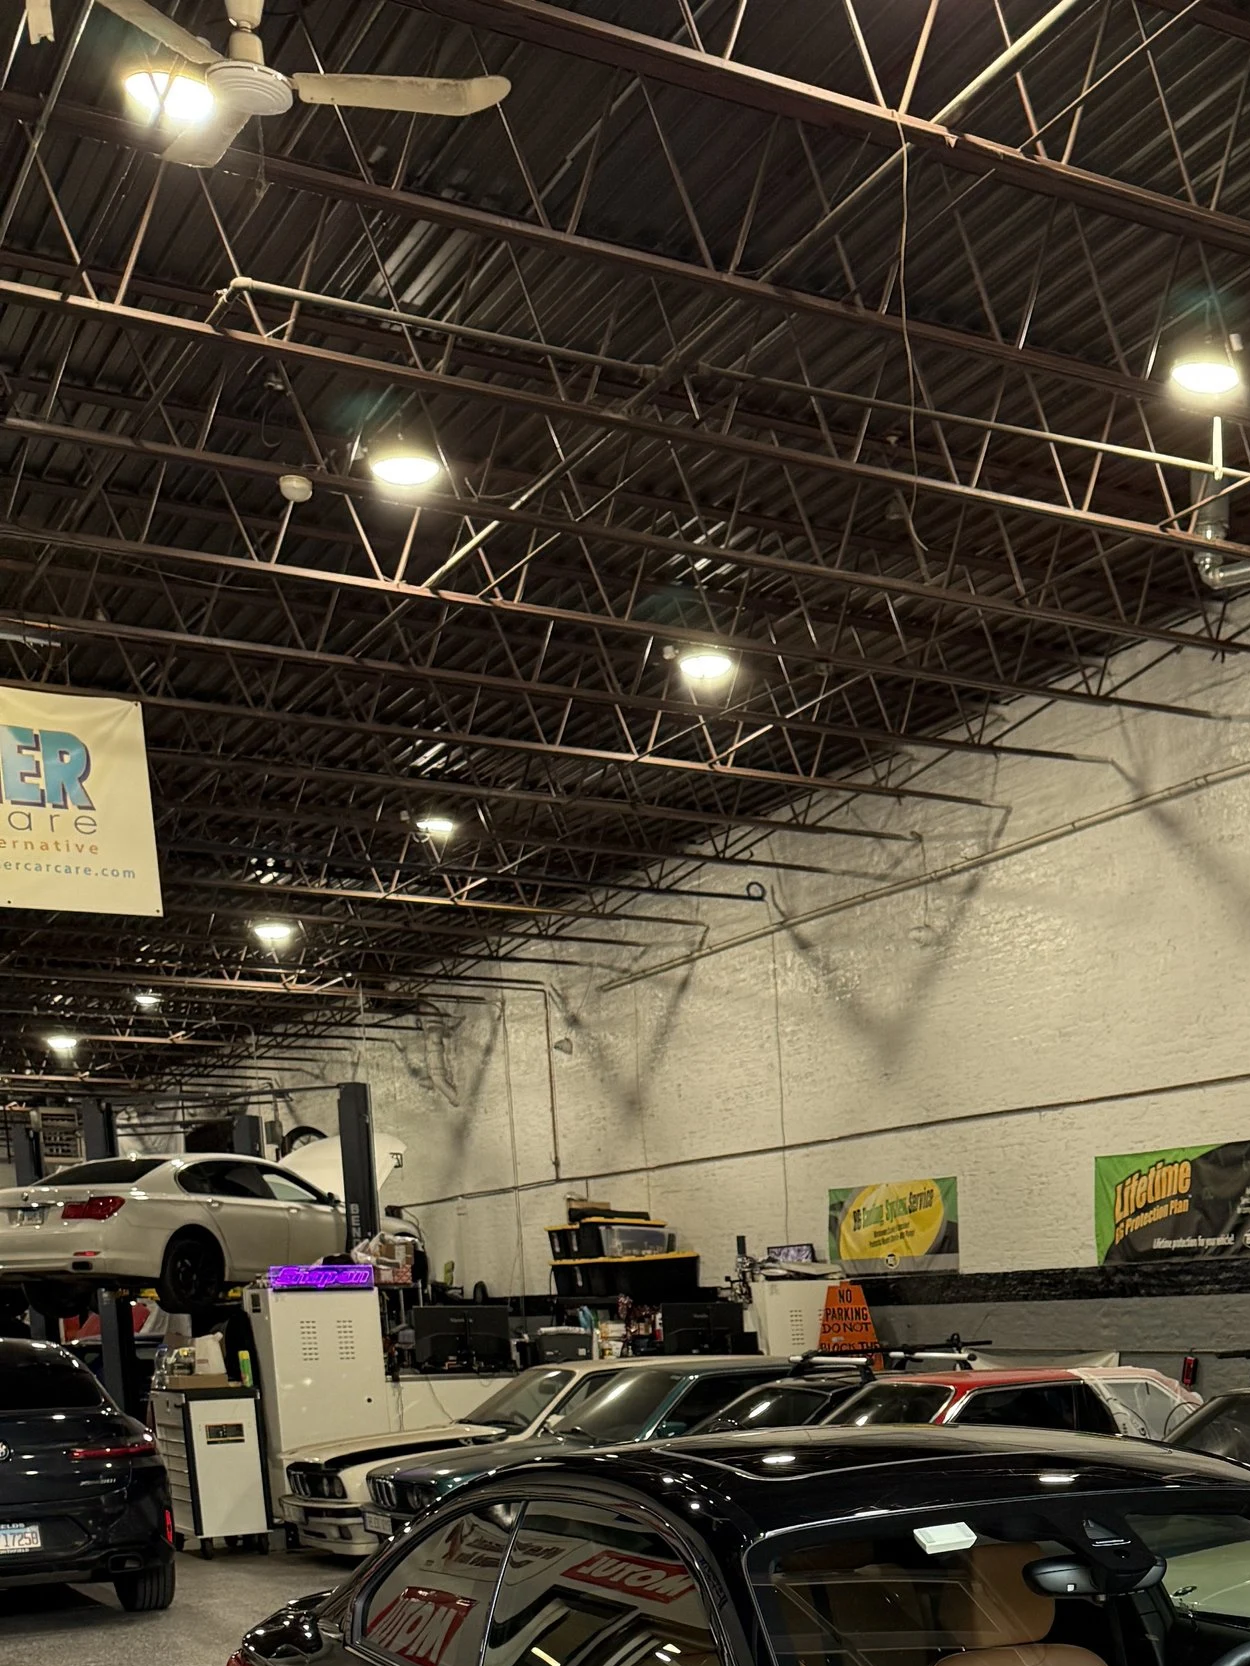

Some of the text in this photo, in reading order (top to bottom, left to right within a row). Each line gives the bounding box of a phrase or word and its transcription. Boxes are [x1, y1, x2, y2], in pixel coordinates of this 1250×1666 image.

[0, 724, 96, 811] ER
[8, 811, 97, 834] are
[0, 838, 98, 854] ernative
[0, 861, 136, 879] ercarcare.com
[1114, 1158, 1192, 1225] Lifetime
[1124, 1204, 1169, 1235] Protection
[1169, 1199, 1189, 1216] Plan
[838, 1289, 853, 1304] NO
[825, 1307, 868, 1321] PARKING
[822, 1322, 871, 1334] DO NOT
